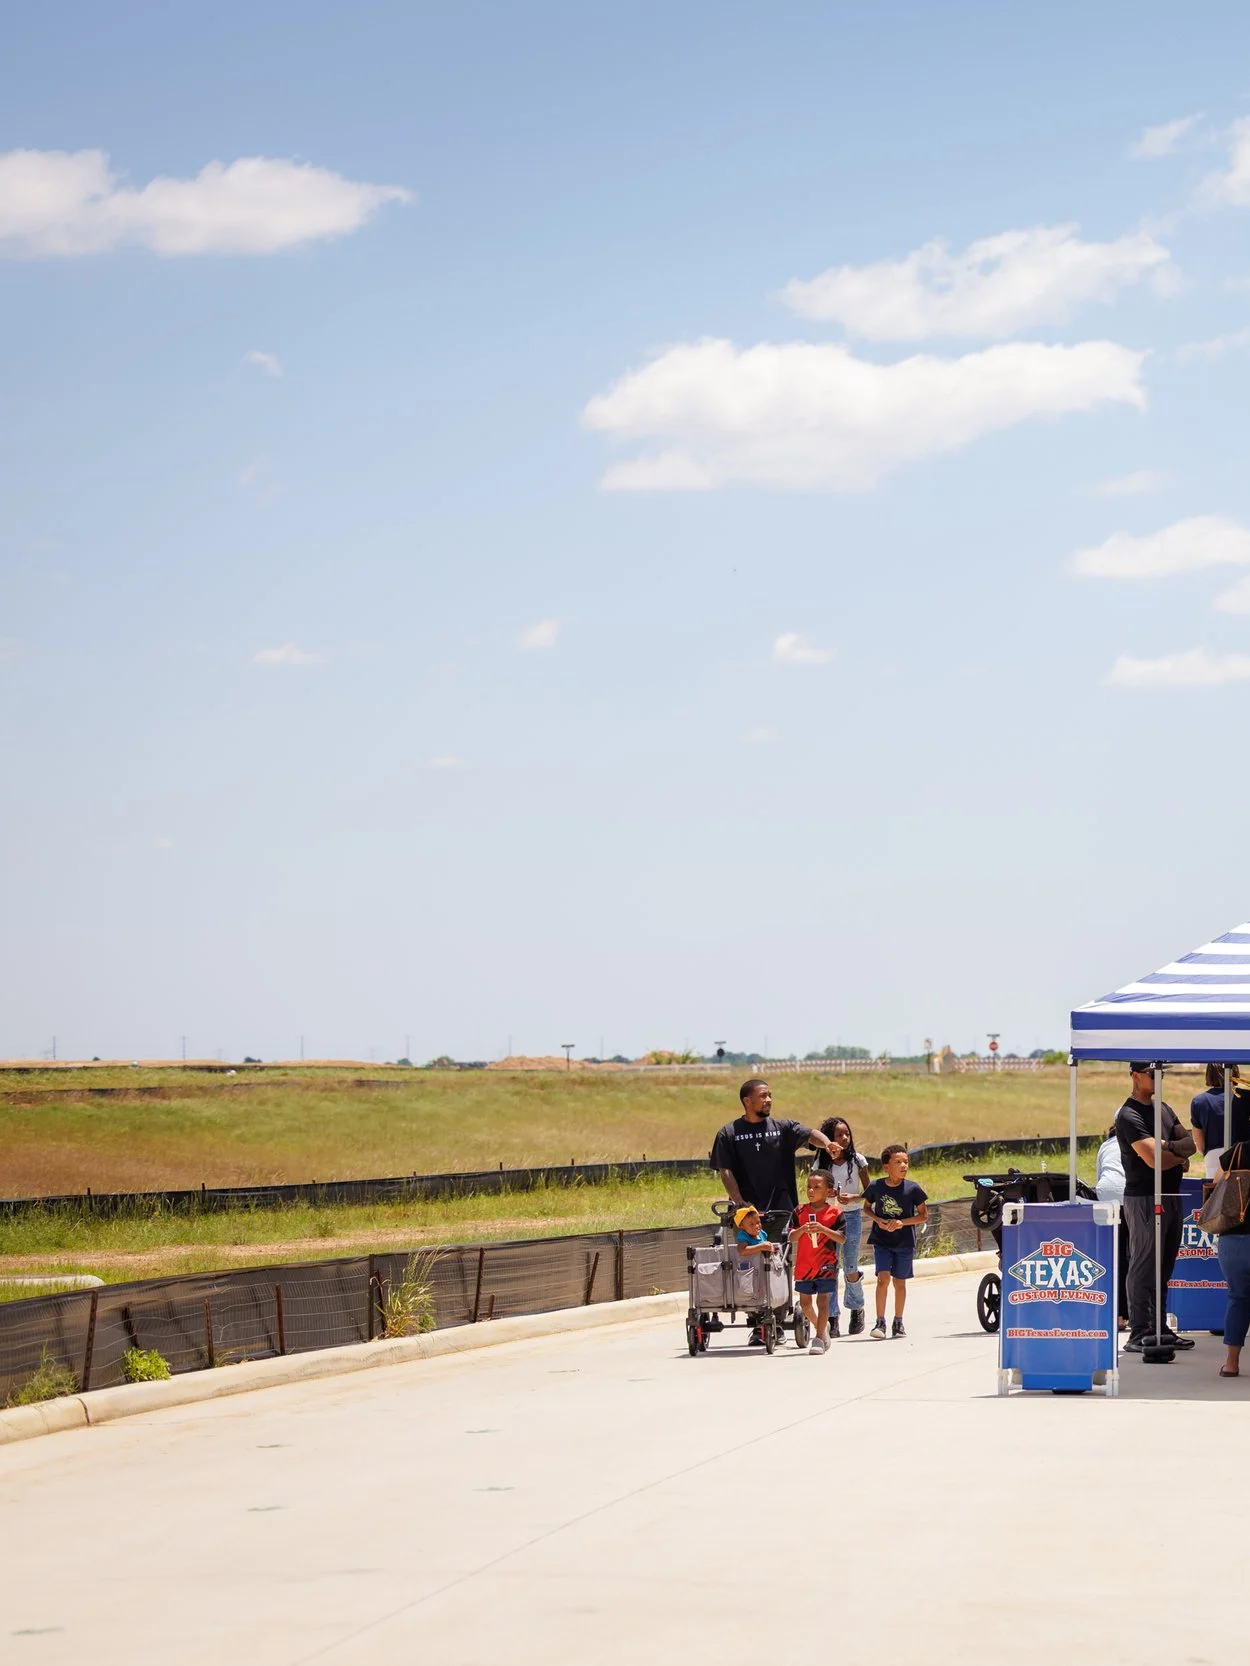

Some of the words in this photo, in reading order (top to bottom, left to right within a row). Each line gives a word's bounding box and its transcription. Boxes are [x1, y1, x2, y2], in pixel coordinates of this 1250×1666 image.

[1042, 1244, 1073, 1256] BIG
[1021, 1257, 1093, 1288] TEXAS
[1011, 1290, 1058, 1302] CUSTOM
[1061, 1290, 1104, 1303] EVENTS
[1008, 1329, 1107, 1338] BIGTexasEvents.com
